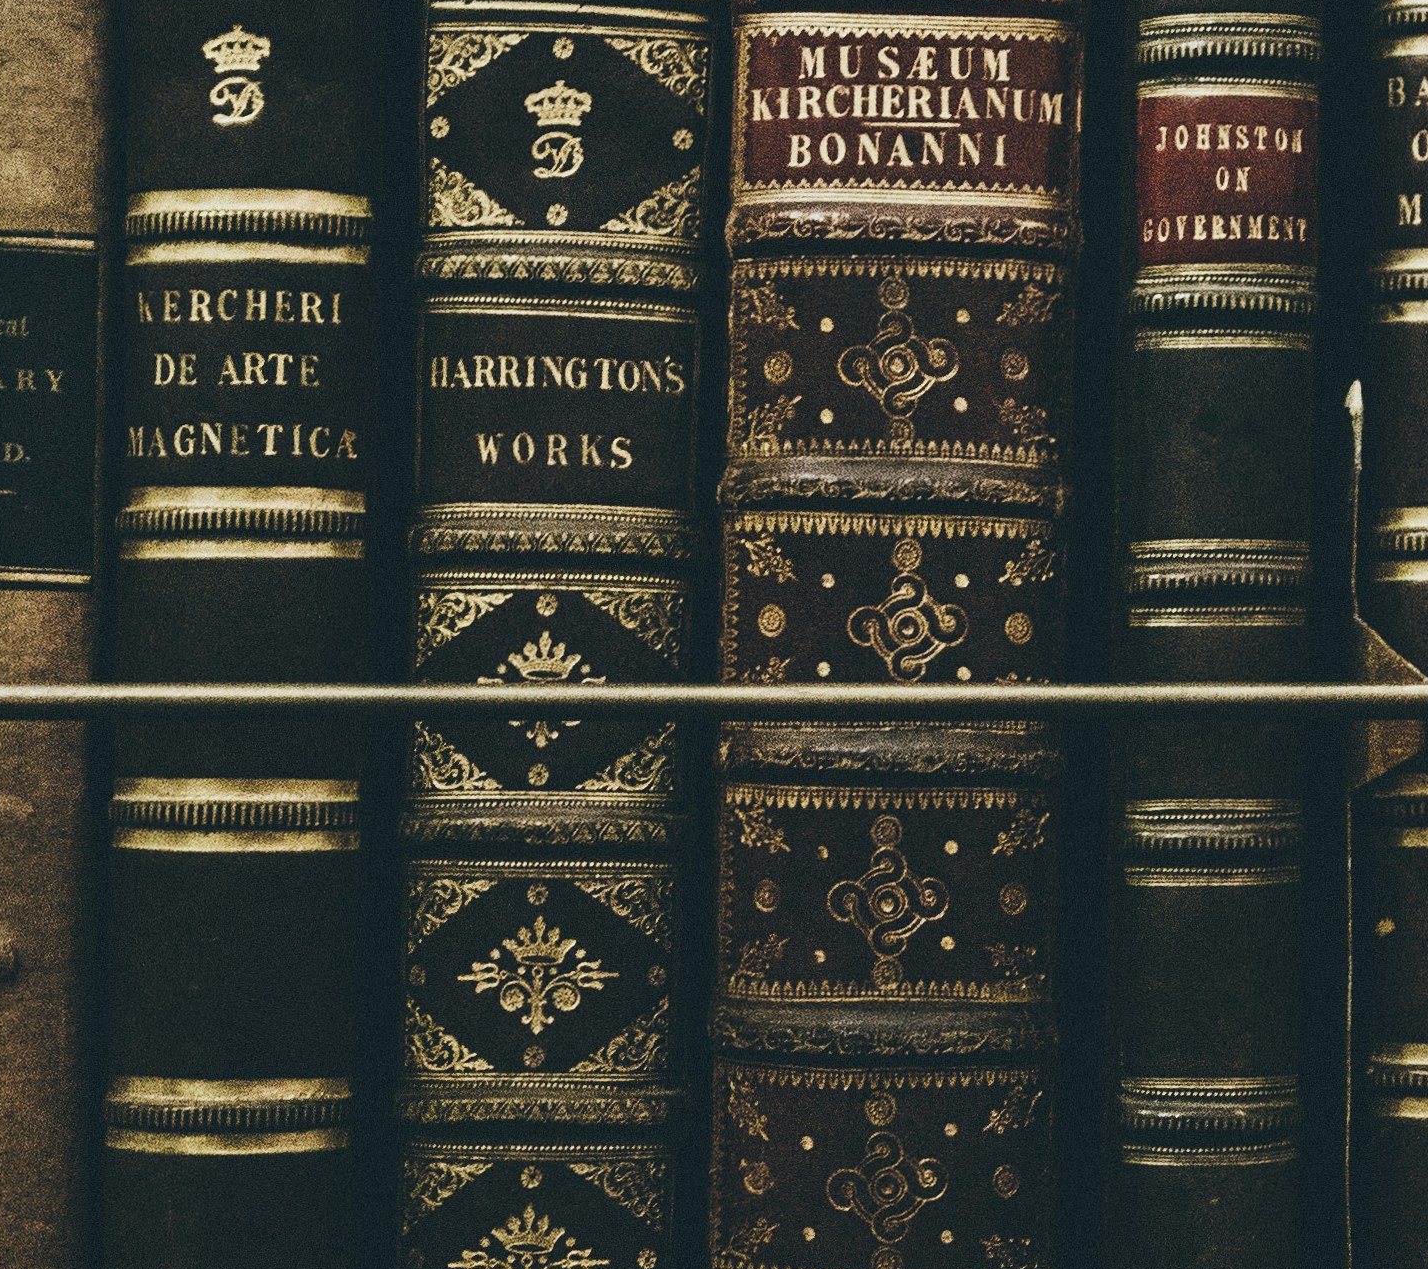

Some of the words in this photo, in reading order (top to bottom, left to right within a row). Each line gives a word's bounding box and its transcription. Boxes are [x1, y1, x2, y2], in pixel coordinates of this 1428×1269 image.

[798, 45, 1011, 81] MUSÆUM
[751, 84, 1065, 126] KIRCHERIANUM
[788, 132, 1007, 168] BONANNI
[1155, 124, 1303, 154] JOHNSTON
[1215, 167, 1250, 192] ON
[1142, 215, 1308, 243] GOVERNMENT
[138, 288, 342, 324] KERCHERI
[153, 352, 198, 387] DE
[218, 352, 320, 387] ARTE
[430, 354, 687, 394] HARRINGTON'S
[476, 432, 634, 469] WORKS
